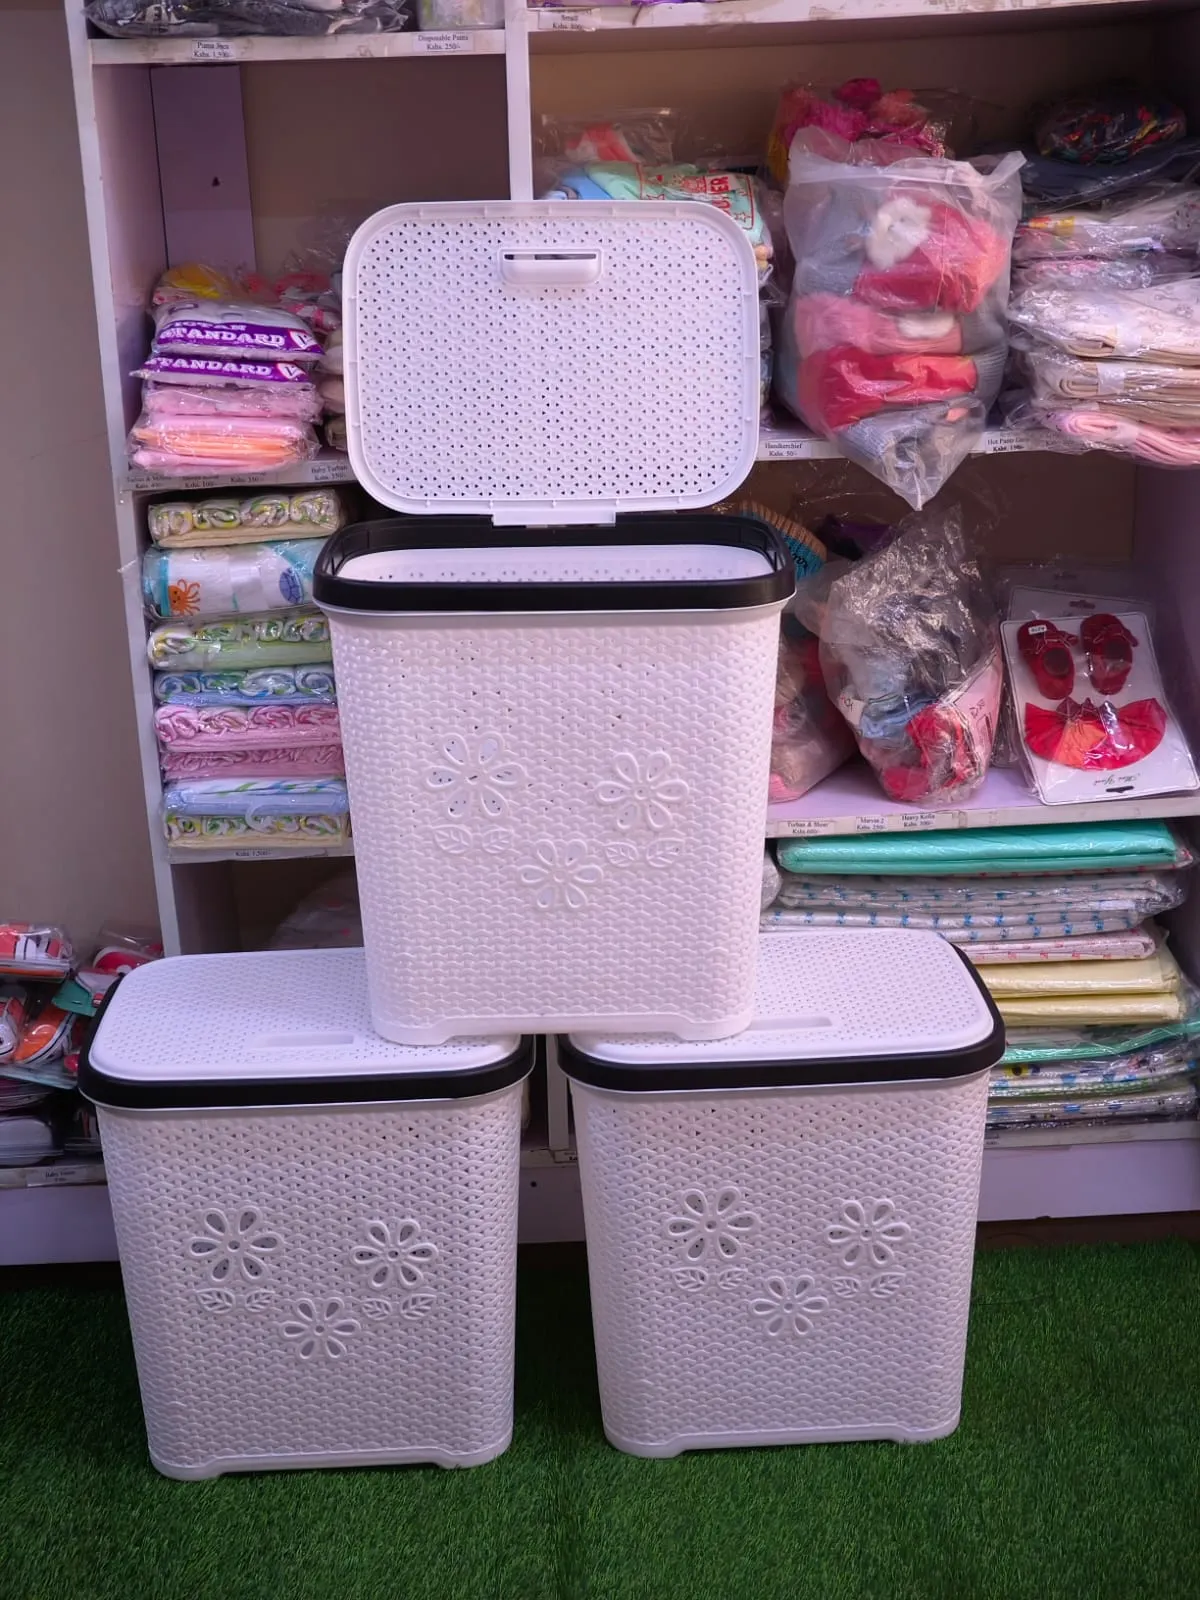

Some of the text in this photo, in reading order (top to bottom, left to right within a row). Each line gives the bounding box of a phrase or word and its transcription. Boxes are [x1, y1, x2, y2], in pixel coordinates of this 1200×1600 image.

[418, 33, 469, 42] Disposable Pants
[160, 326, 286, 348] STANDARD
[145, 357, 272, 377] STANDARD
[765, 441, 802, 450] Handkerchief
